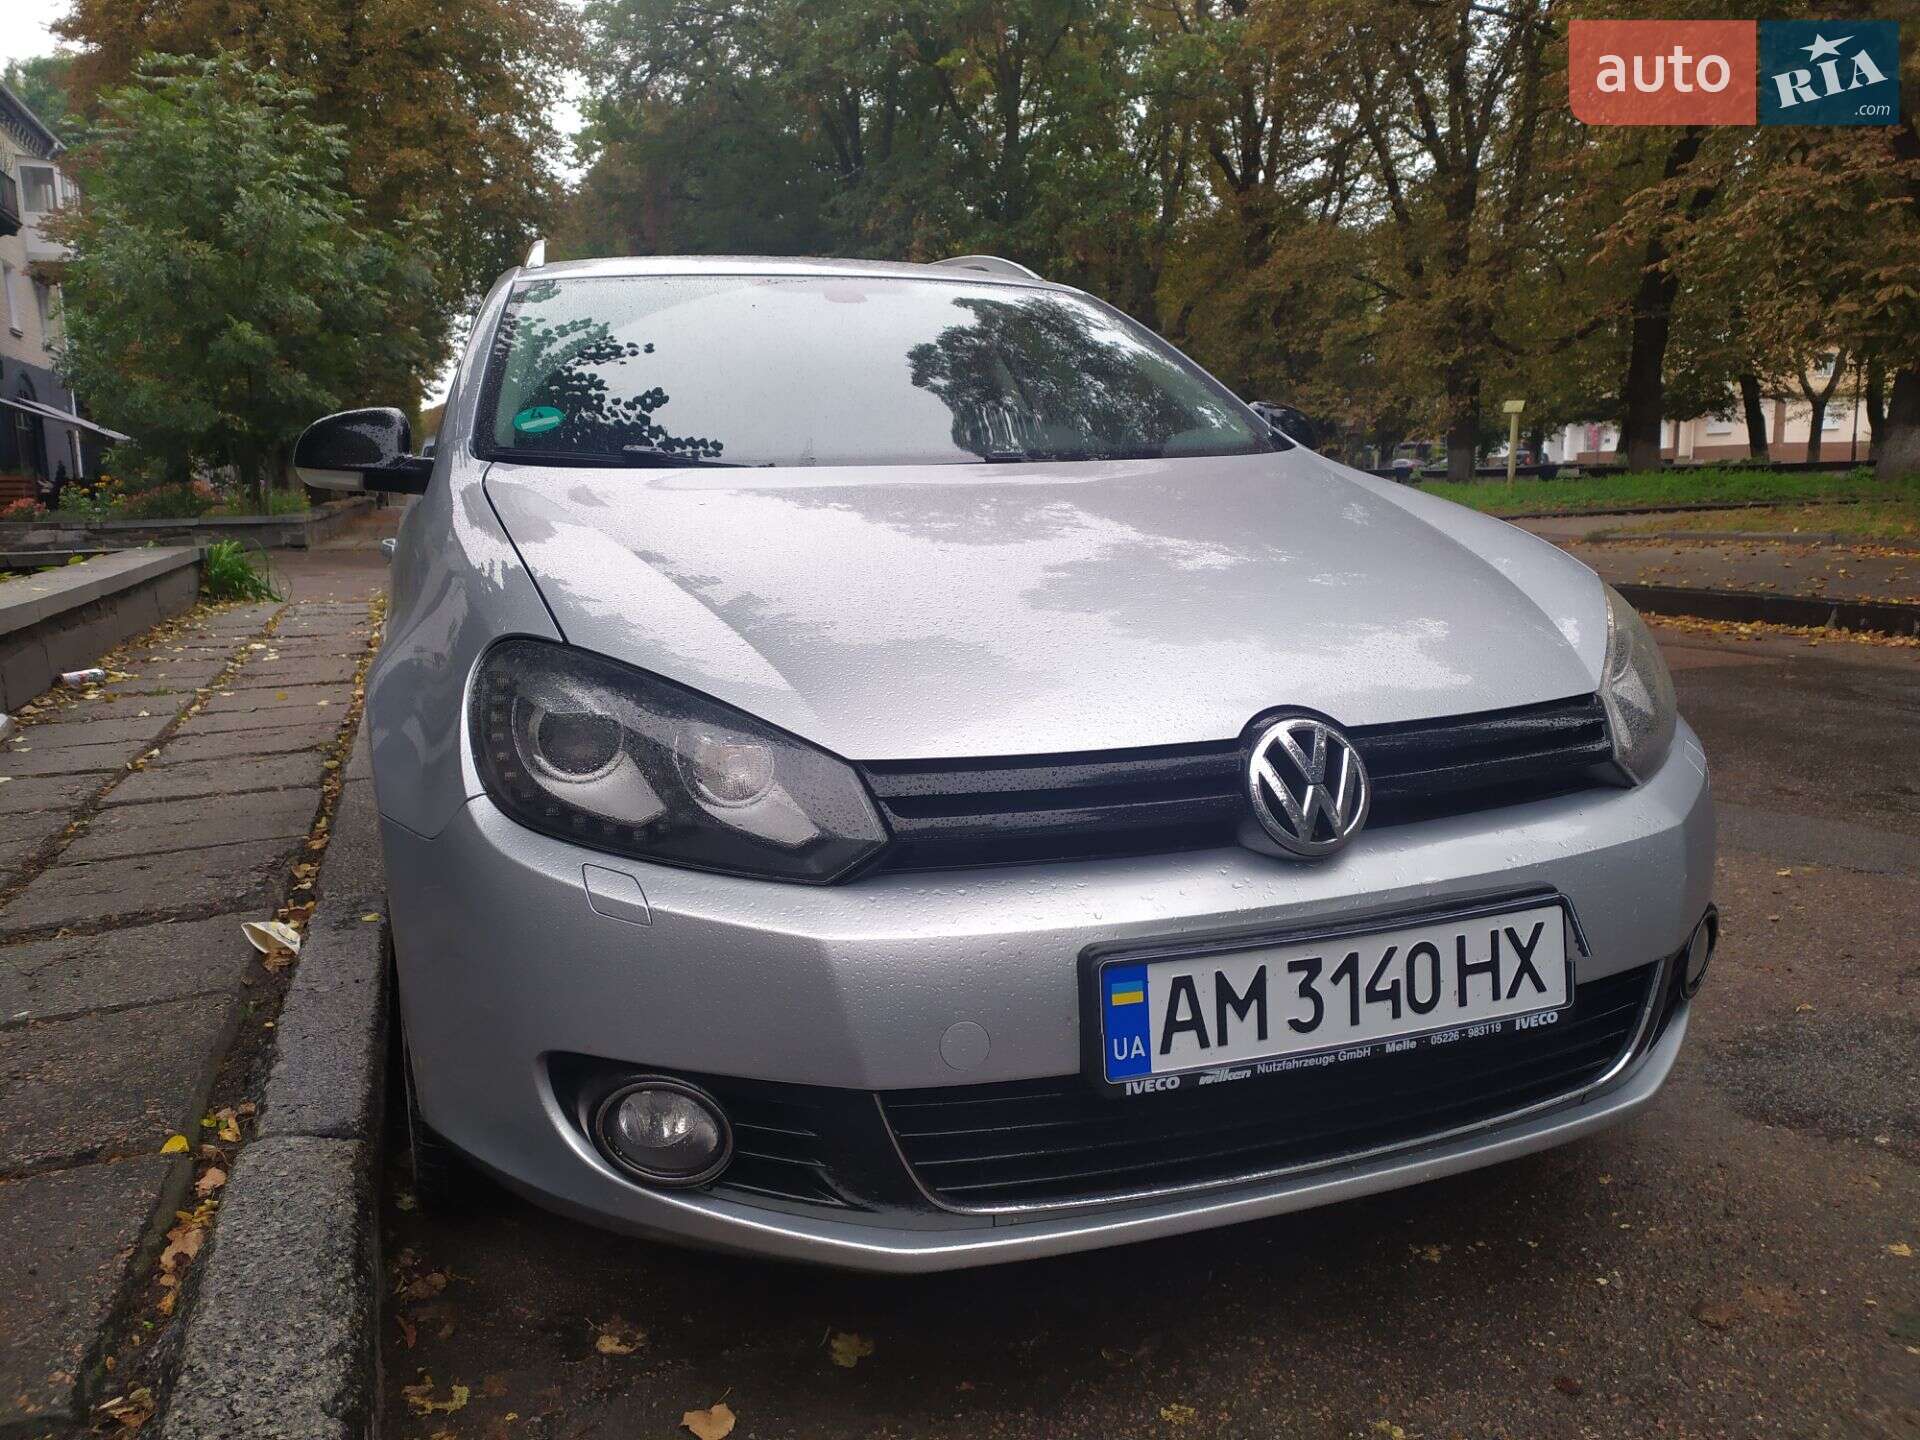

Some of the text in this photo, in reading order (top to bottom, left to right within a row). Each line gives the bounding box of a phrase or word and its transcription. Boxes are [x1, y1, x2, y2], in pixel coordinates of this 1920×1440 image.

[1159, 921, 1548, 1055] AM 3140 HX
[1112, 1035, 1146, 1061] UA
[1125, 1076, 1181, 1096] IVECO
[1256, 1052, 1336, 1074] Nutzfahrzeuge
[1338, 1047, 1371, 1062] GmbH
[1385, 1039, 1417, 1054] Melle
[1430, 1031, 1460, 1046] 05226
[1467, 1023, 1502, 1039] 983119
[1514, 1011, 1559, 1031] IVECO
